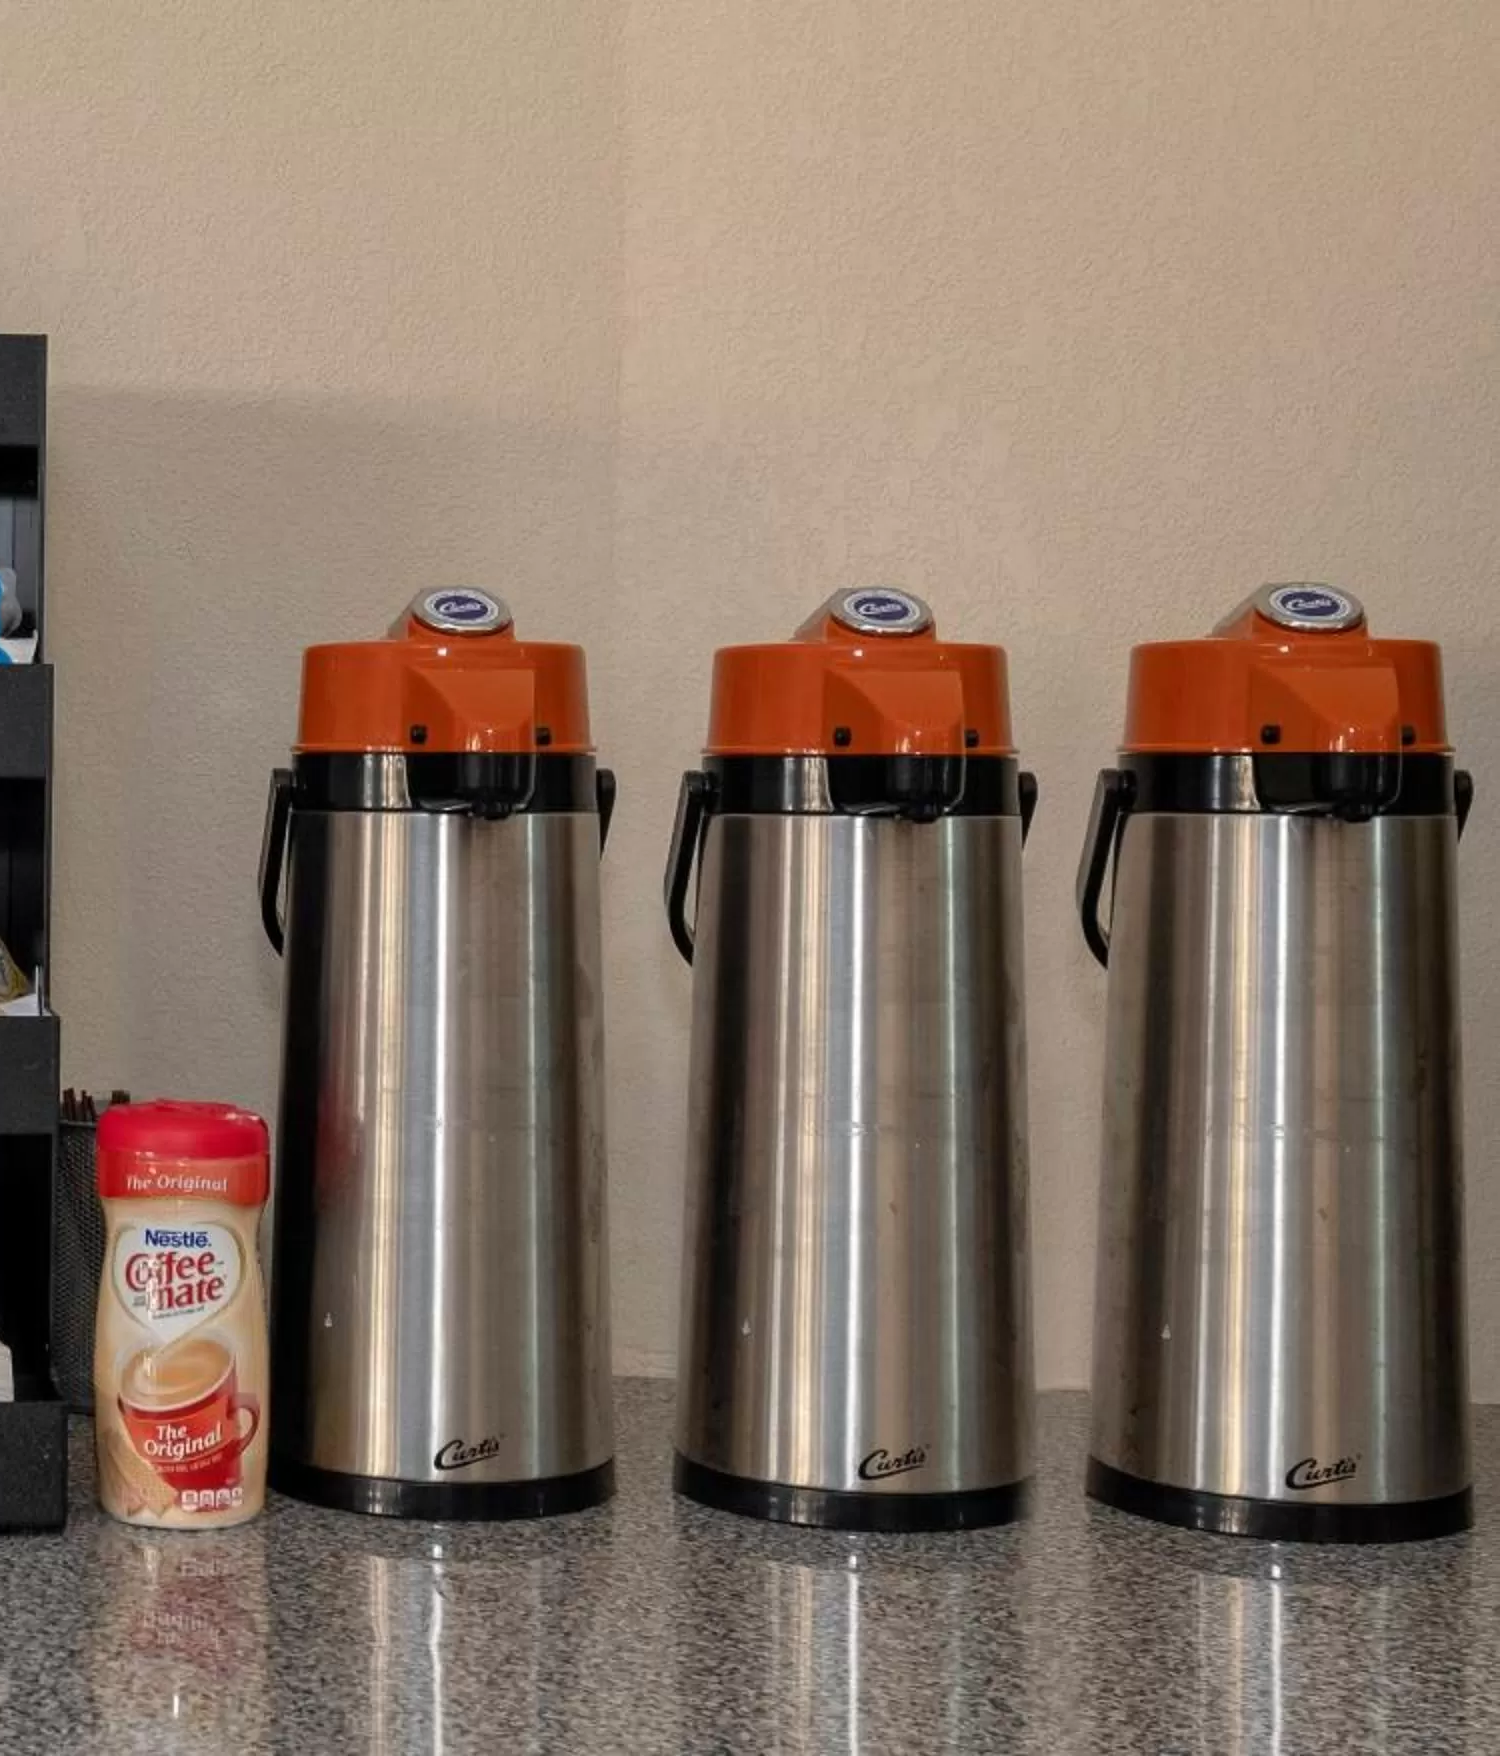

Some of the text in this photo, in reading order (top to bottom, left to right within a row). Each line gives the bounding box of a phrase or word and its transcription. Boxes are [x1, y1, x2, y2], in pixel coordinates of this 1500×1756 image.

[127, 1174, 228, 1193] The Original
[145, 1228, 209, 1248] Nestlé
[144, 1420, 222, 1460] Original
[156, 1423, 188, 1441] The
[434, 1436, 501, 1471] Curtis
[858, 1448, 925, 1481] Curtis
[1285, 1457, 1357, 1491] Curtis
